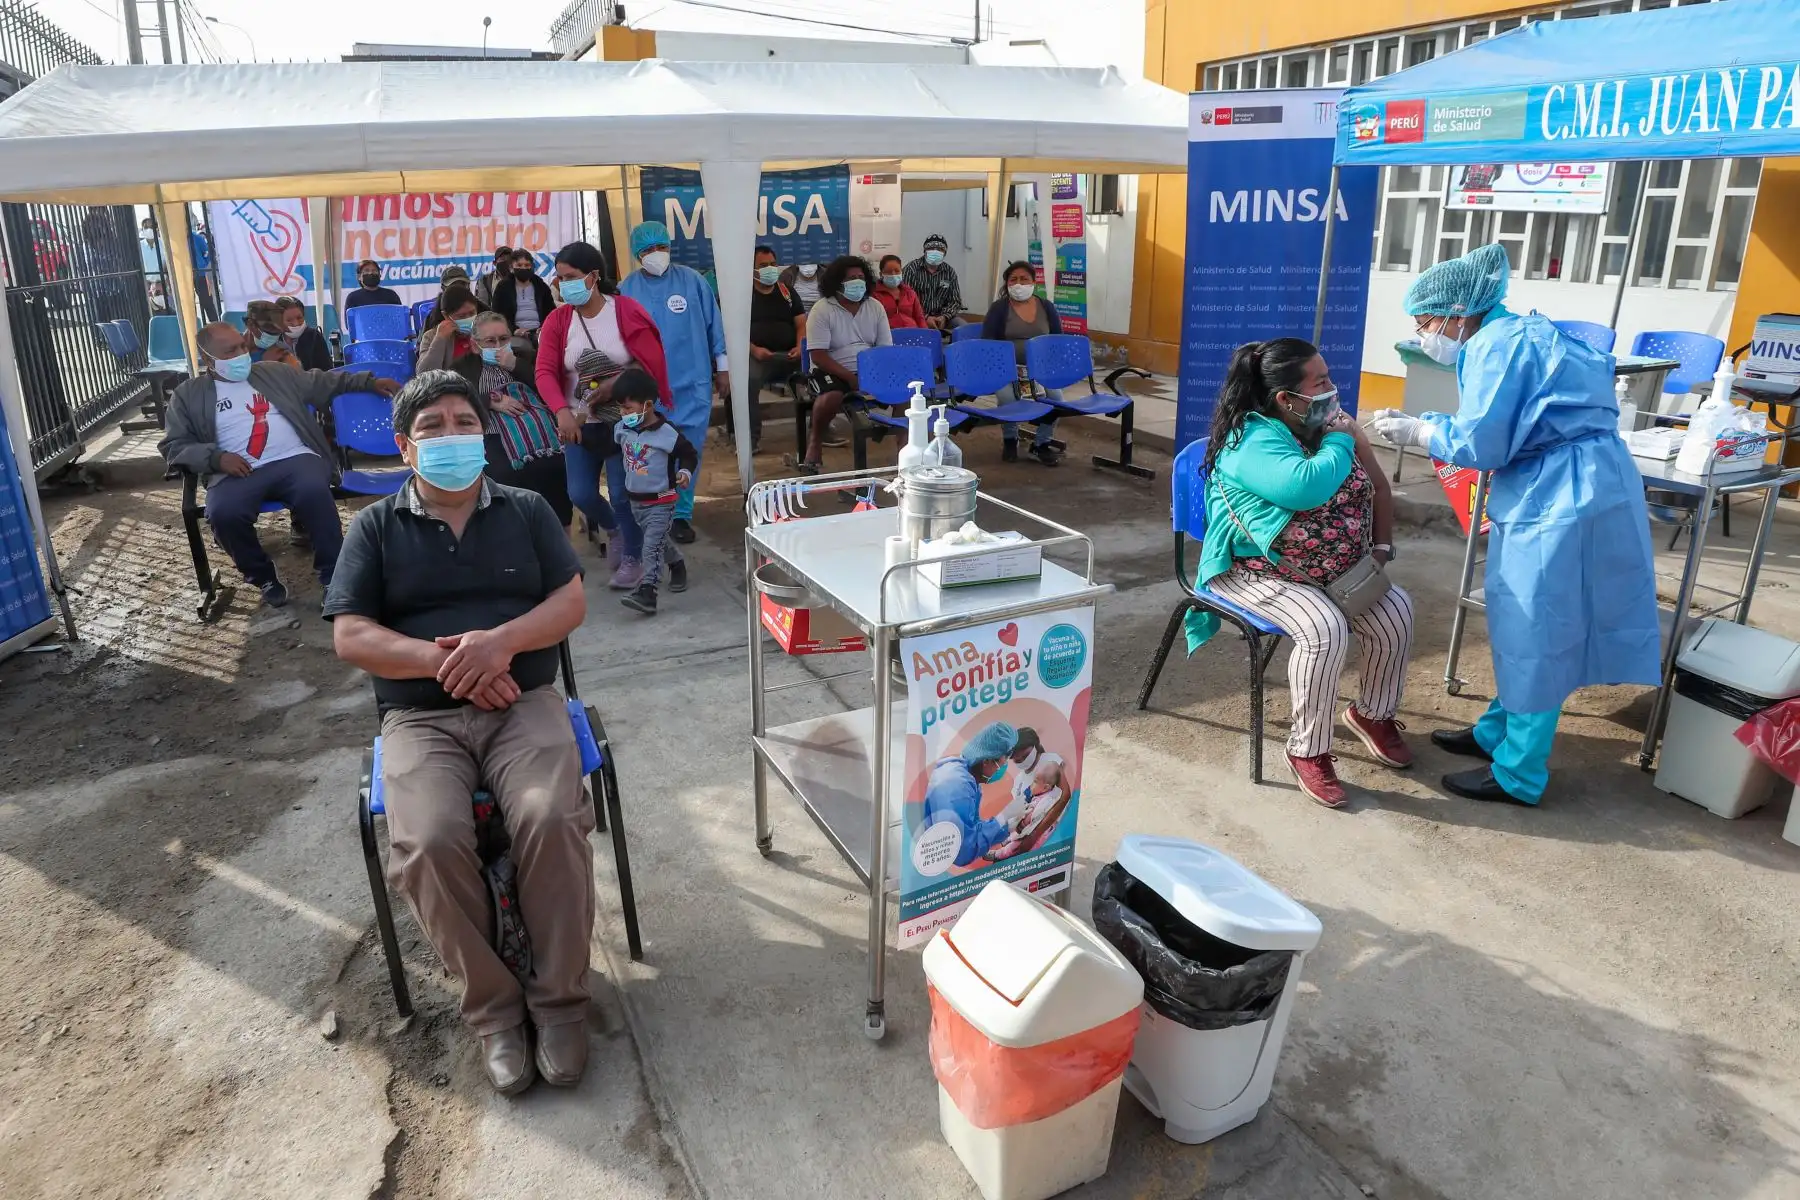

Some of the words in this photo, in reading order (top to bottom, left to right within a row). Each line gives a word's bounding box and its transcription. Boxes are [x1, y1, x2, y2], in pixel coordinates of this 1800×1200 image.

[1541, 79, 1630, 140] C.M.I.
[1638, 68, 1748, 136] JUAN
[1434, 105, 1492, 119] Ministerio
[1390, 114, 1419, 129] PERÚ
[1433, 122, 1447, 133] de
[1449, 119, 1481, 132] Salud
[1210, 188, 1348, 223] MINSA
[342, 218, 548, 261] ncuentro
[1193, 265, 1234, 274] Ministerio
[1236, 266, 1247, 274] de
[1249, 265, 1272, 274] Salud
[1338, 265, 1361, 274] Salud
[1191, 304, 1232, 312] Ministerio
[1234, 304, 1244, 312] de
[1246, 304, 1270, 312] Salud
[1334, 304, 1358, 312] Salud
[1189, 341, 1230, 350] Ministerio
[1331, 343, 1355, 351] Salud
[936, 649, 1020, 698] confía
[1022, 649, 1032, 668] y
[921, 671, 1029, 735] protege
[925, 847, 950, 860] menores
[1017, 856, 1038, 867] lugares
[919, 898, 942, 910] ingresa
